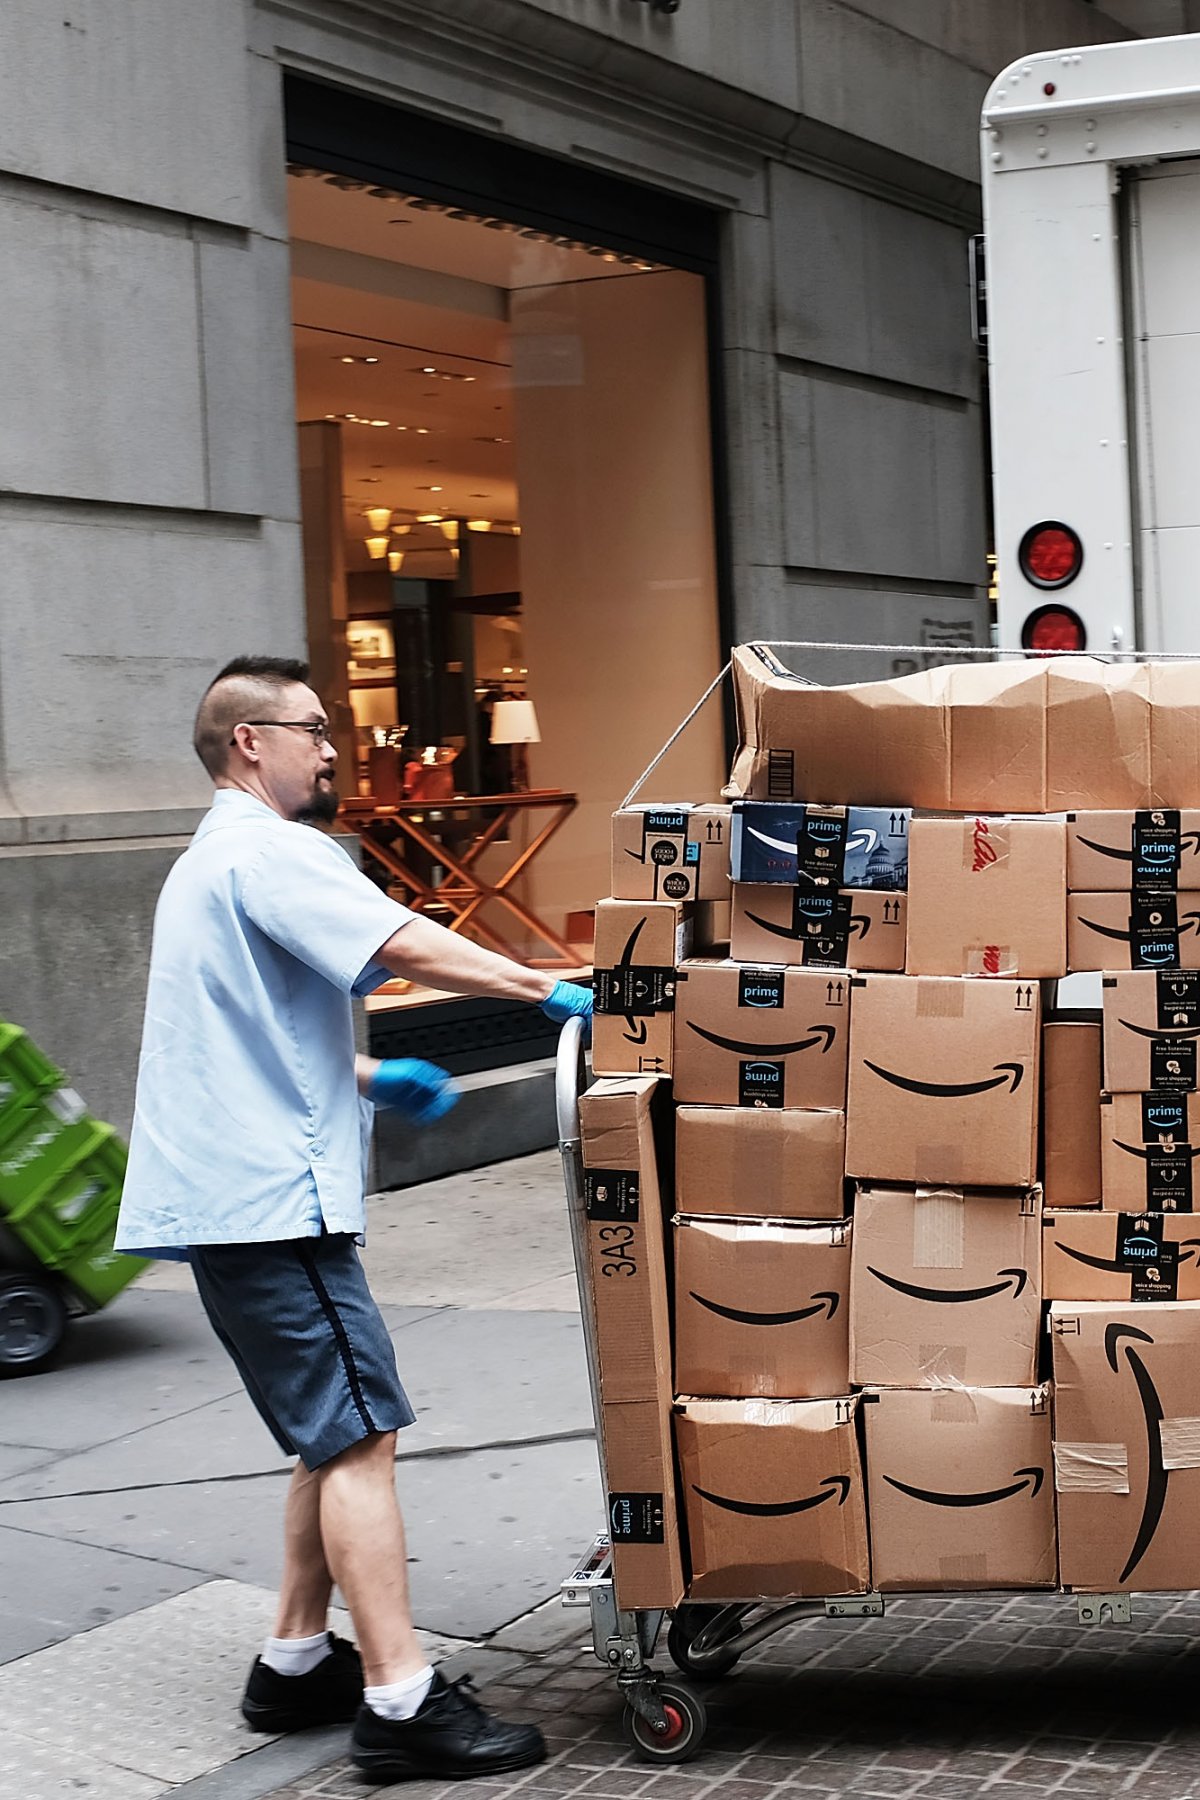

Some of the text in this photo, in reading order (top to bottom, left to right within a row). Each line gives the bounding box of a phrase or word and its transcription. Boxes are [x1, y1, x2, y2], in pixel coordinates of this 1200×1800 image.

[649, 815, 684, 828] prime
[807, 820, 842, 832] prime
[1141, 842, 1176, 855] prime
[817, 860, 837, 869] delivery
[798, 896, 833, 907] prime
[1140, 941, 1175, 955] prime
[744, 985, 779, 998] prime
[745, 1072, 779, 1084] prime
[1148, 1105, 1182, 1119] prime
[599, 1225, 637, 1277] 3A3
[1123, 1247, 1158, 1259] prime
[620, 1500, 633, 1534] prime
